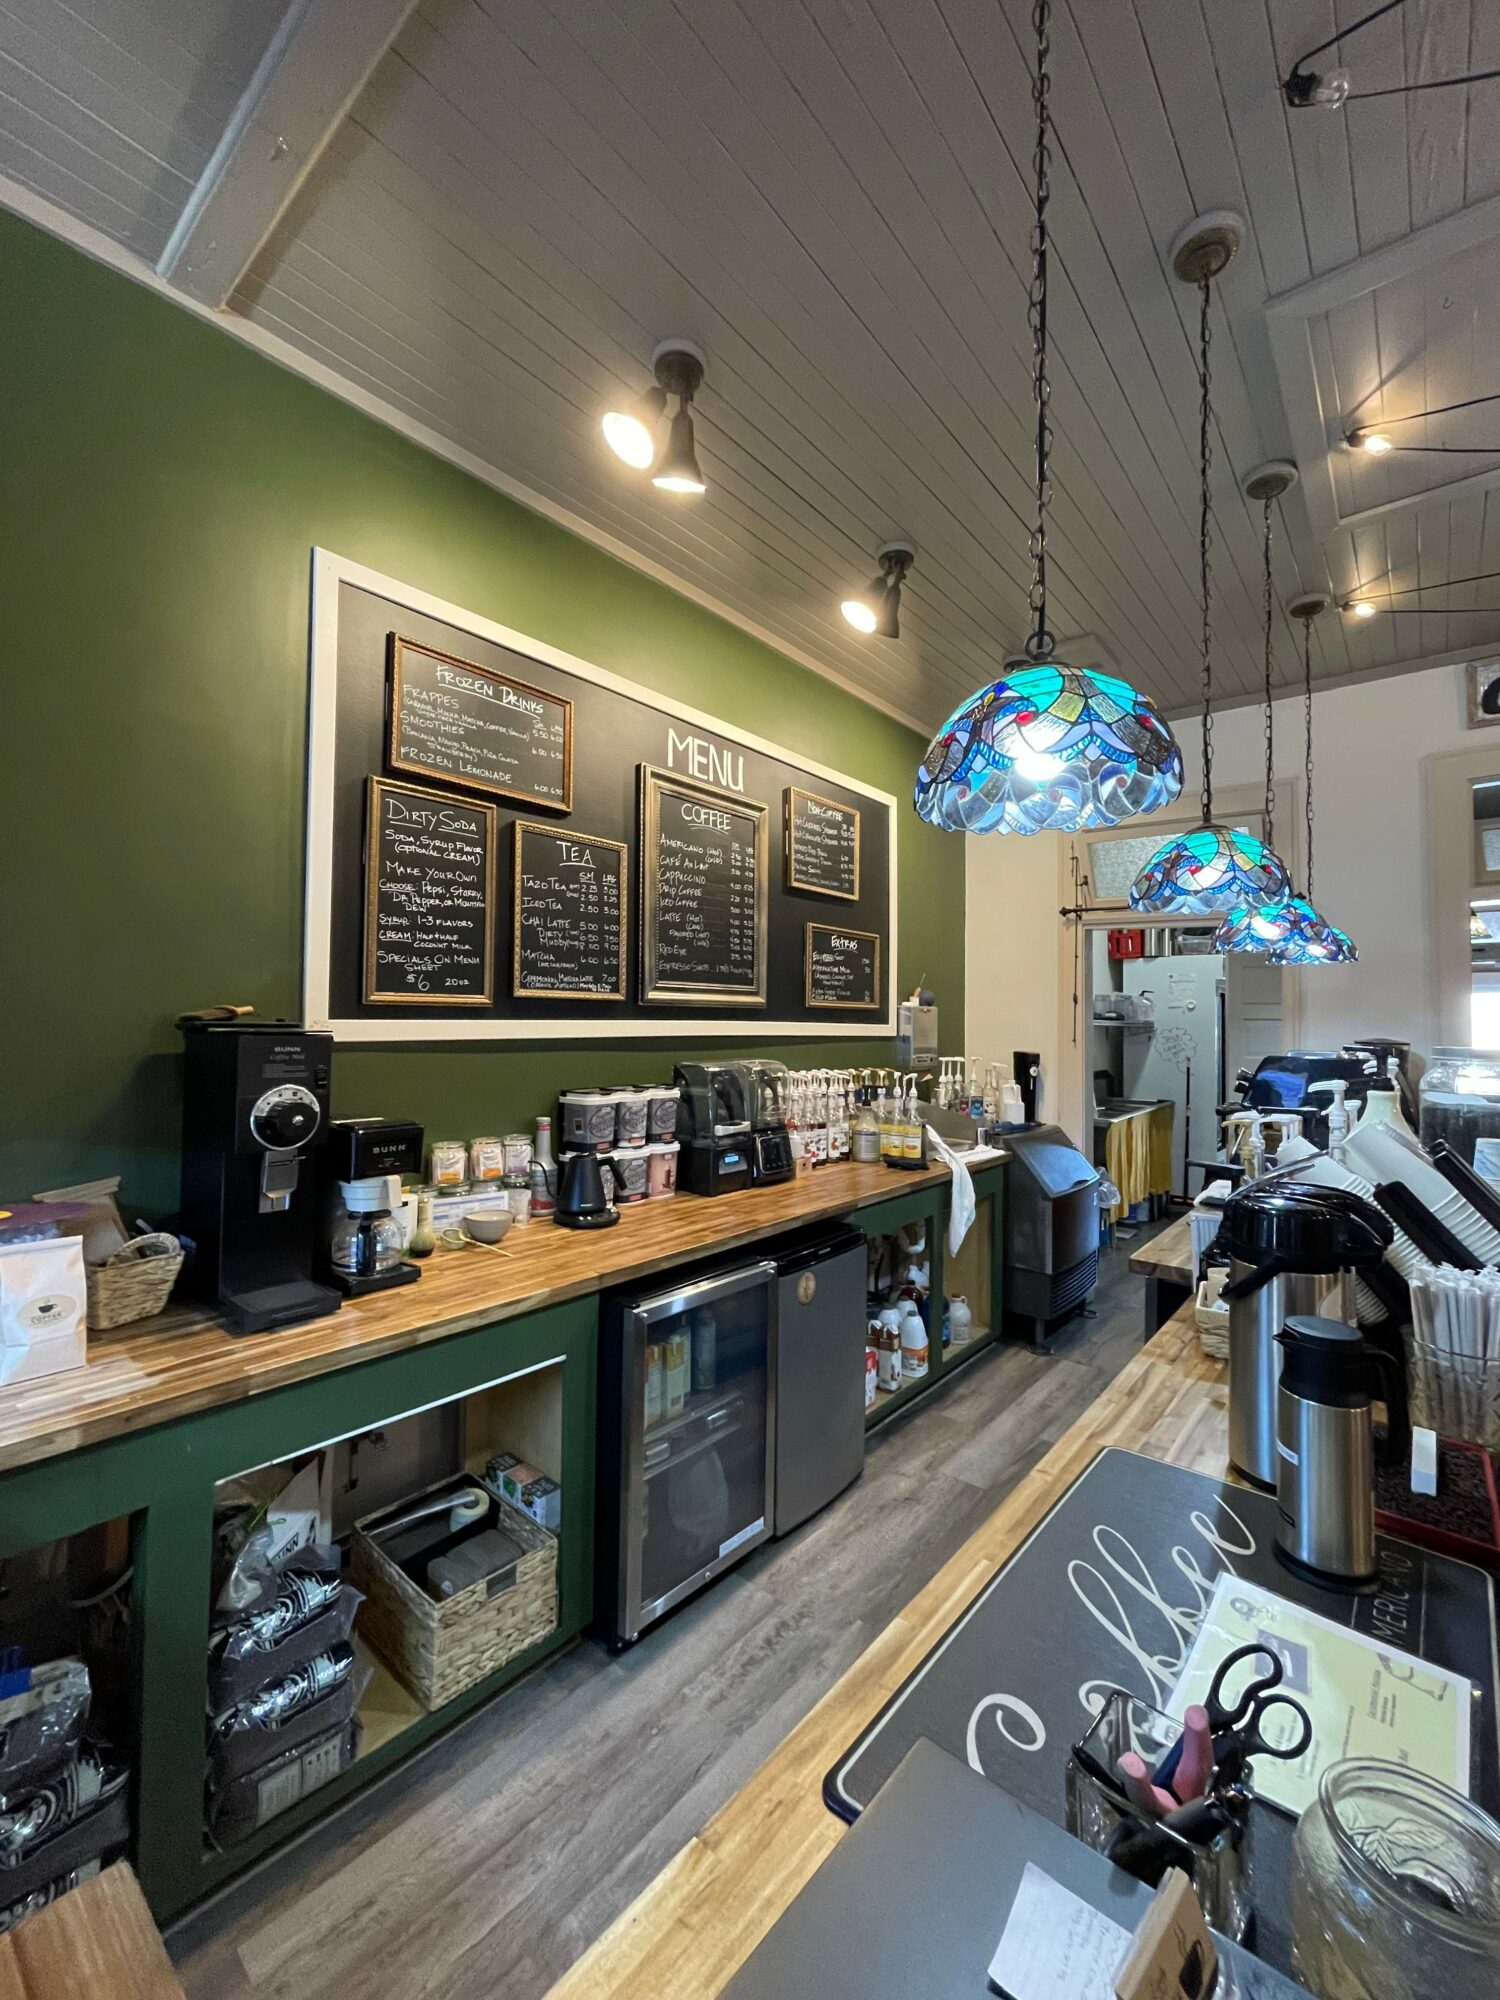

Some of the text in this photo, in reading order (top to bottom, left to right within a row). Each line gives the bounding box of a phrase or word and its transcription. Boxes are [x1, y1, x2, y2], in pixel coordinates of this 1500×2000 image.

[436, 665, 544, 713] FROZEN DRINKS
[403, 684, 459, 709] FRAPPES
[400, 711, 464, 734] SMOOTHIES
[400, 746, 512, 783] FROZEN LEMONADE
[667, 728, 744, 792] MENU
[385, 798, 477, 831] DIRTY SODA
[681, 803, 732, 830] COFFEE
[820, 807, 843, 821] COFFEE
[385, 829, 419, 845] SODA,
[660, 833, 704, 854] AMERICANO
[443, 851, 480, 866] CREAM)
[556, 841, 593, 866] TEA
[660, 854, 682, 866] CAFÉ
[386, 860, 477, 882] MAKE YOUR OWN
[579, 871, 594, 882] SM
[659, 868, 706, 886] CAPPUCCINO
[547, 877, 567, 891] TEA
[659, 882, 677, 898] DRIP
[678, 885, 702, 897] COFFEE
[402, 902, 427, 912] DEW
[522, 897, 546, 908] ICED
[545, 898, 563, 910] TEA
[660, 897, 699, 909] ICED COFFEE
[417, 915, 434, 926] 1-3
[436, 919, 473, 927] FLAVORS
[521, 913, 543, 927] CHAI
[547, 916, 572, 929] LATTE
[659, 911, 682, 922] LATTE
[536, 928, 564, 938] DIRTY
[413, 940, 448, 949] COCONUT
[539, 937, 567, 951] MUDDY
[659, 943, 673, 956] RED
[673, 945, 688, 956] EYE
[831, 935, 858, 950] EXTRAS
[377, 950, 480, 964] SPECIALS ON MENU
[522, 949, 555, 961] MATCHA
[404, 964, 442, 972] SHEET
[659, 960, 690, 974] ESPRESSO
[405, 973, 430, 991] $6
[372, 1144, 406, 1154] BUNN
